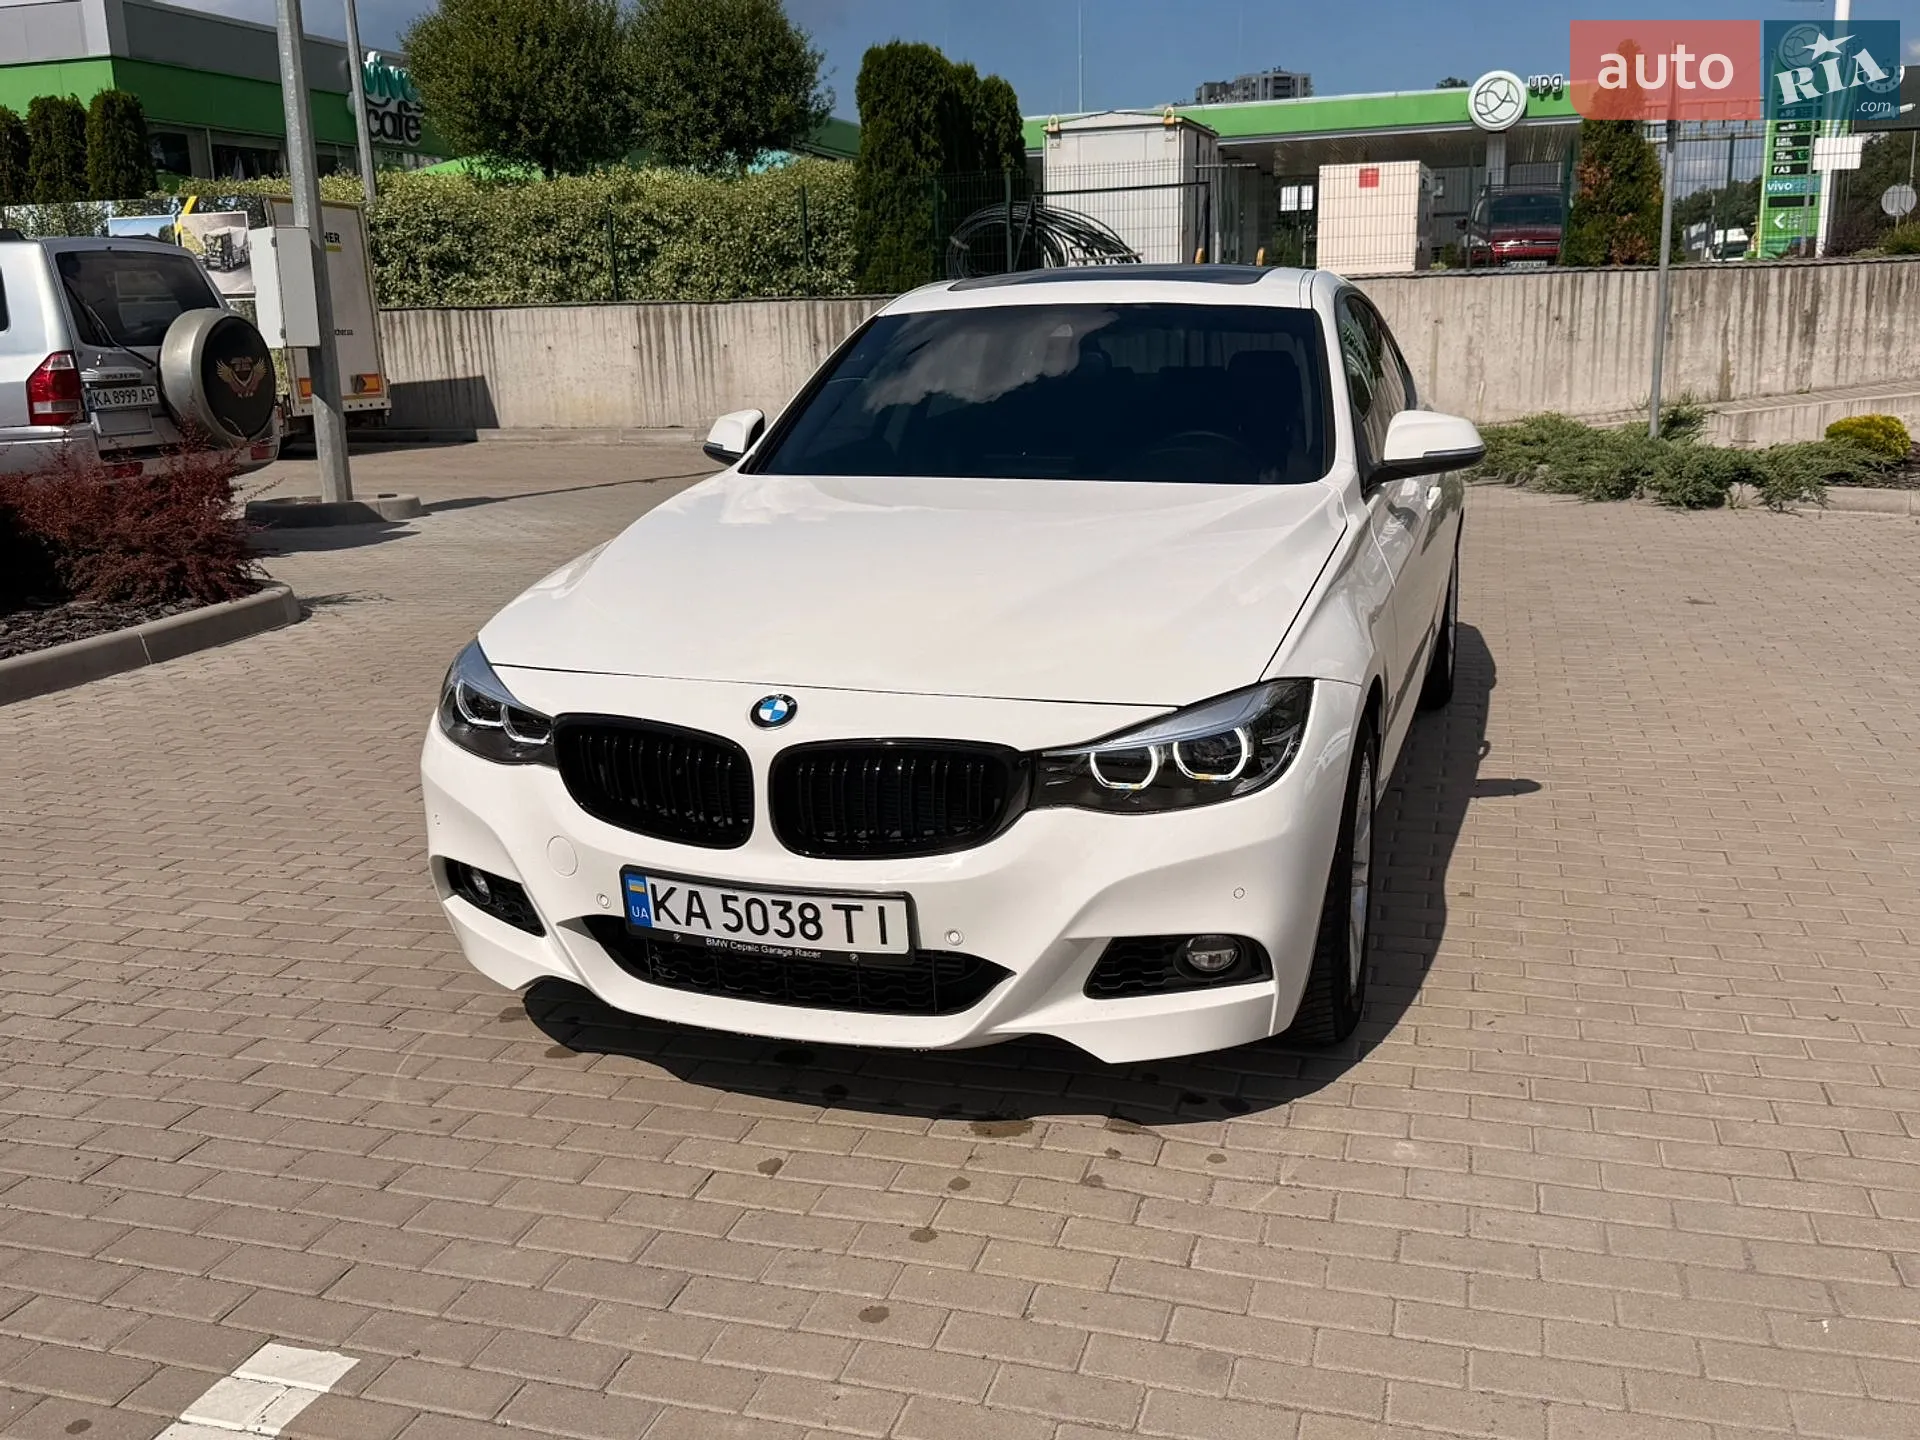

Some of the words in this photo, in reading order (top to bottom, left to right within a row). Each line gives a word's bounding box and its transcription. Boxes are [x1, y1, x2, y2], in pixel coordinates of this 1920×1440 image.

[1528, 74, 1563, 95] upg
[1767, 180, 1793, 191] vivo
[631, 904, 649, 920] UA
[650, 882, 712, 931] KA
[720, 893, 824, 942] 5038
